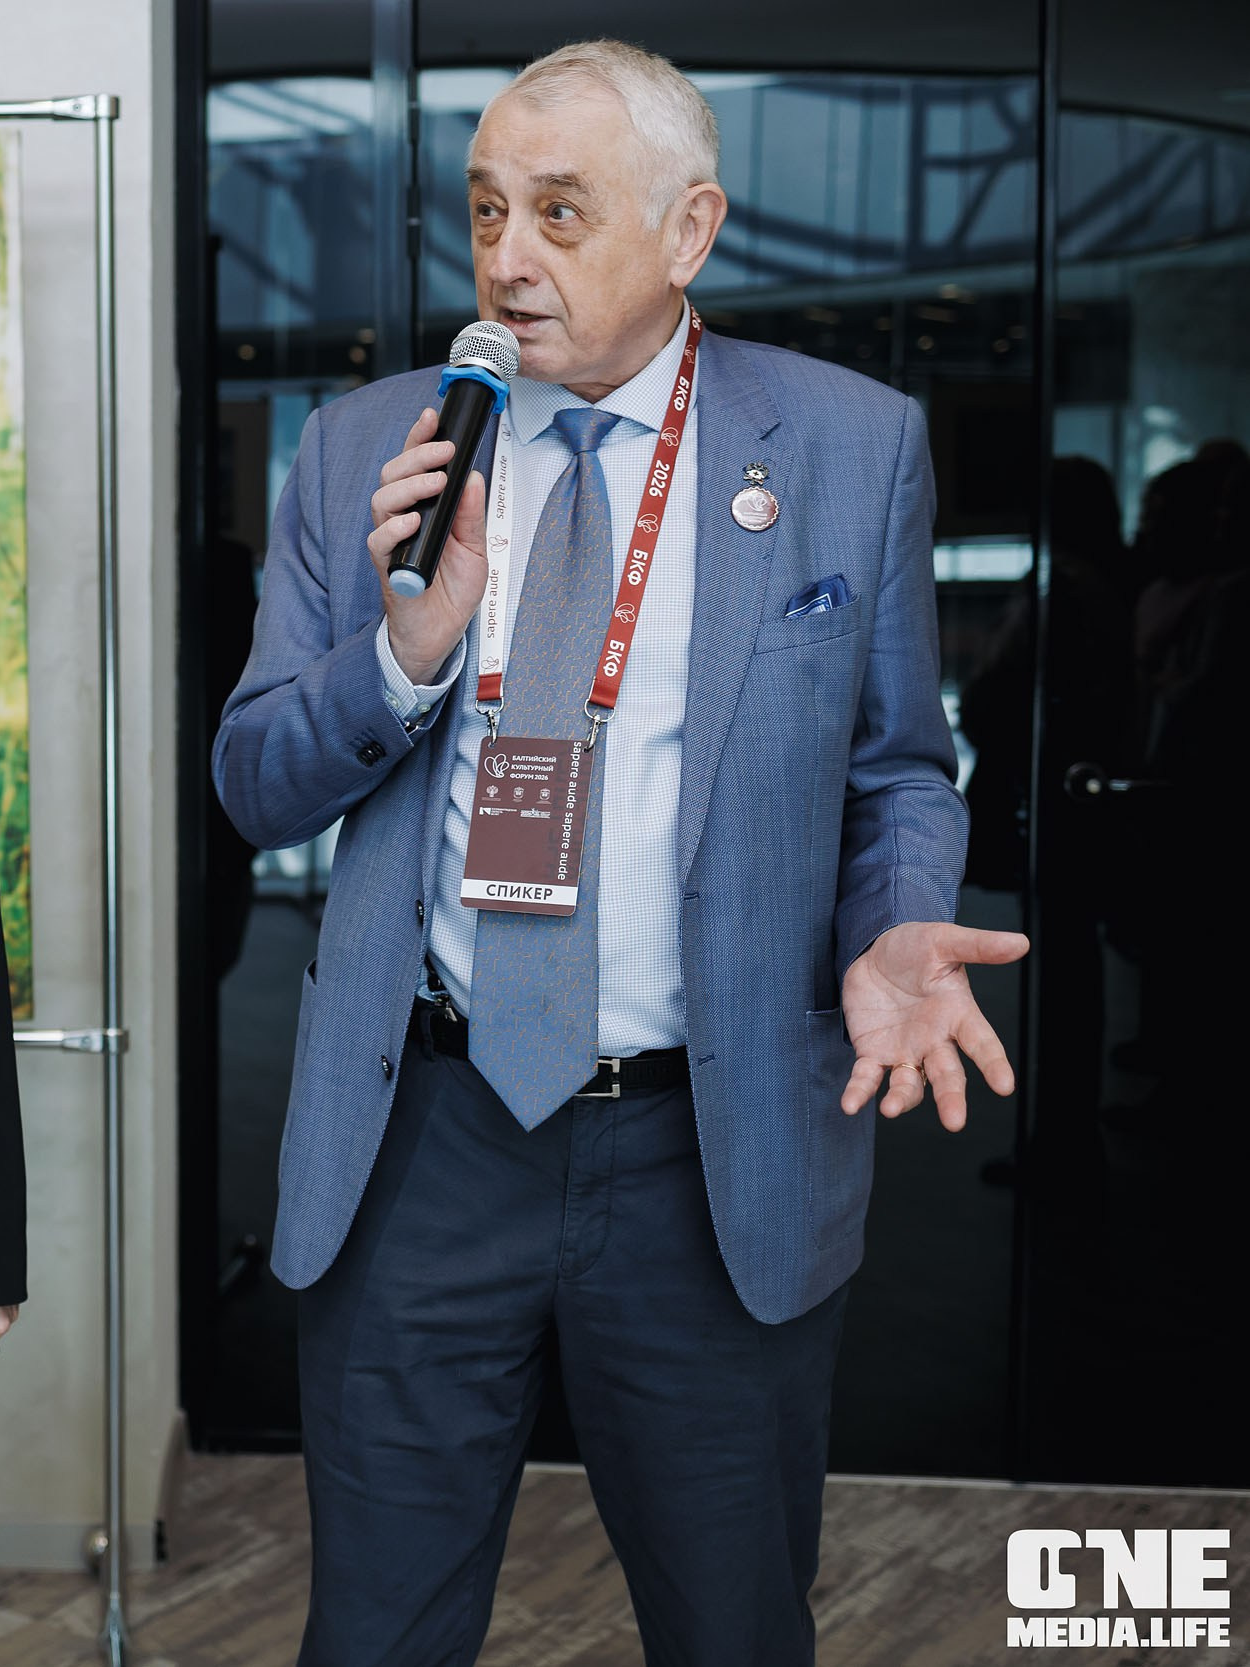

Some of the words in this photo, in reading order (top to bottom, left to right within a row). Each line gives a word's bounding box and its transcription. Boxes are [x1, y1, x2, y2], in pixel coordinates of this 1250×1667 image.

[674, 376, 690, 412] БКФ
[500, 456, 508, 482] aude
[649, 460, 670, 498] 2026
[496, 484, 506, 520] sapere
[490, 569, 499, 597] aude
[627, 548, 648, 586] БКФ
[487, 600, 498, 639] sapere
[602, 640, 625, 677] БКФ
[510, 764, 554, 772] КУЛЬТУРНЫЙ
[512, 755, 557, 764] БАЛТИЙСКИЙ
[569, 742, 582, 778] sapere
[566, 781, 578, 810] aude
[562, 812, 574, 850] sapere
[558, 852, 568, 880] aude
[486, 884, 553, 901] СПИКЕР
